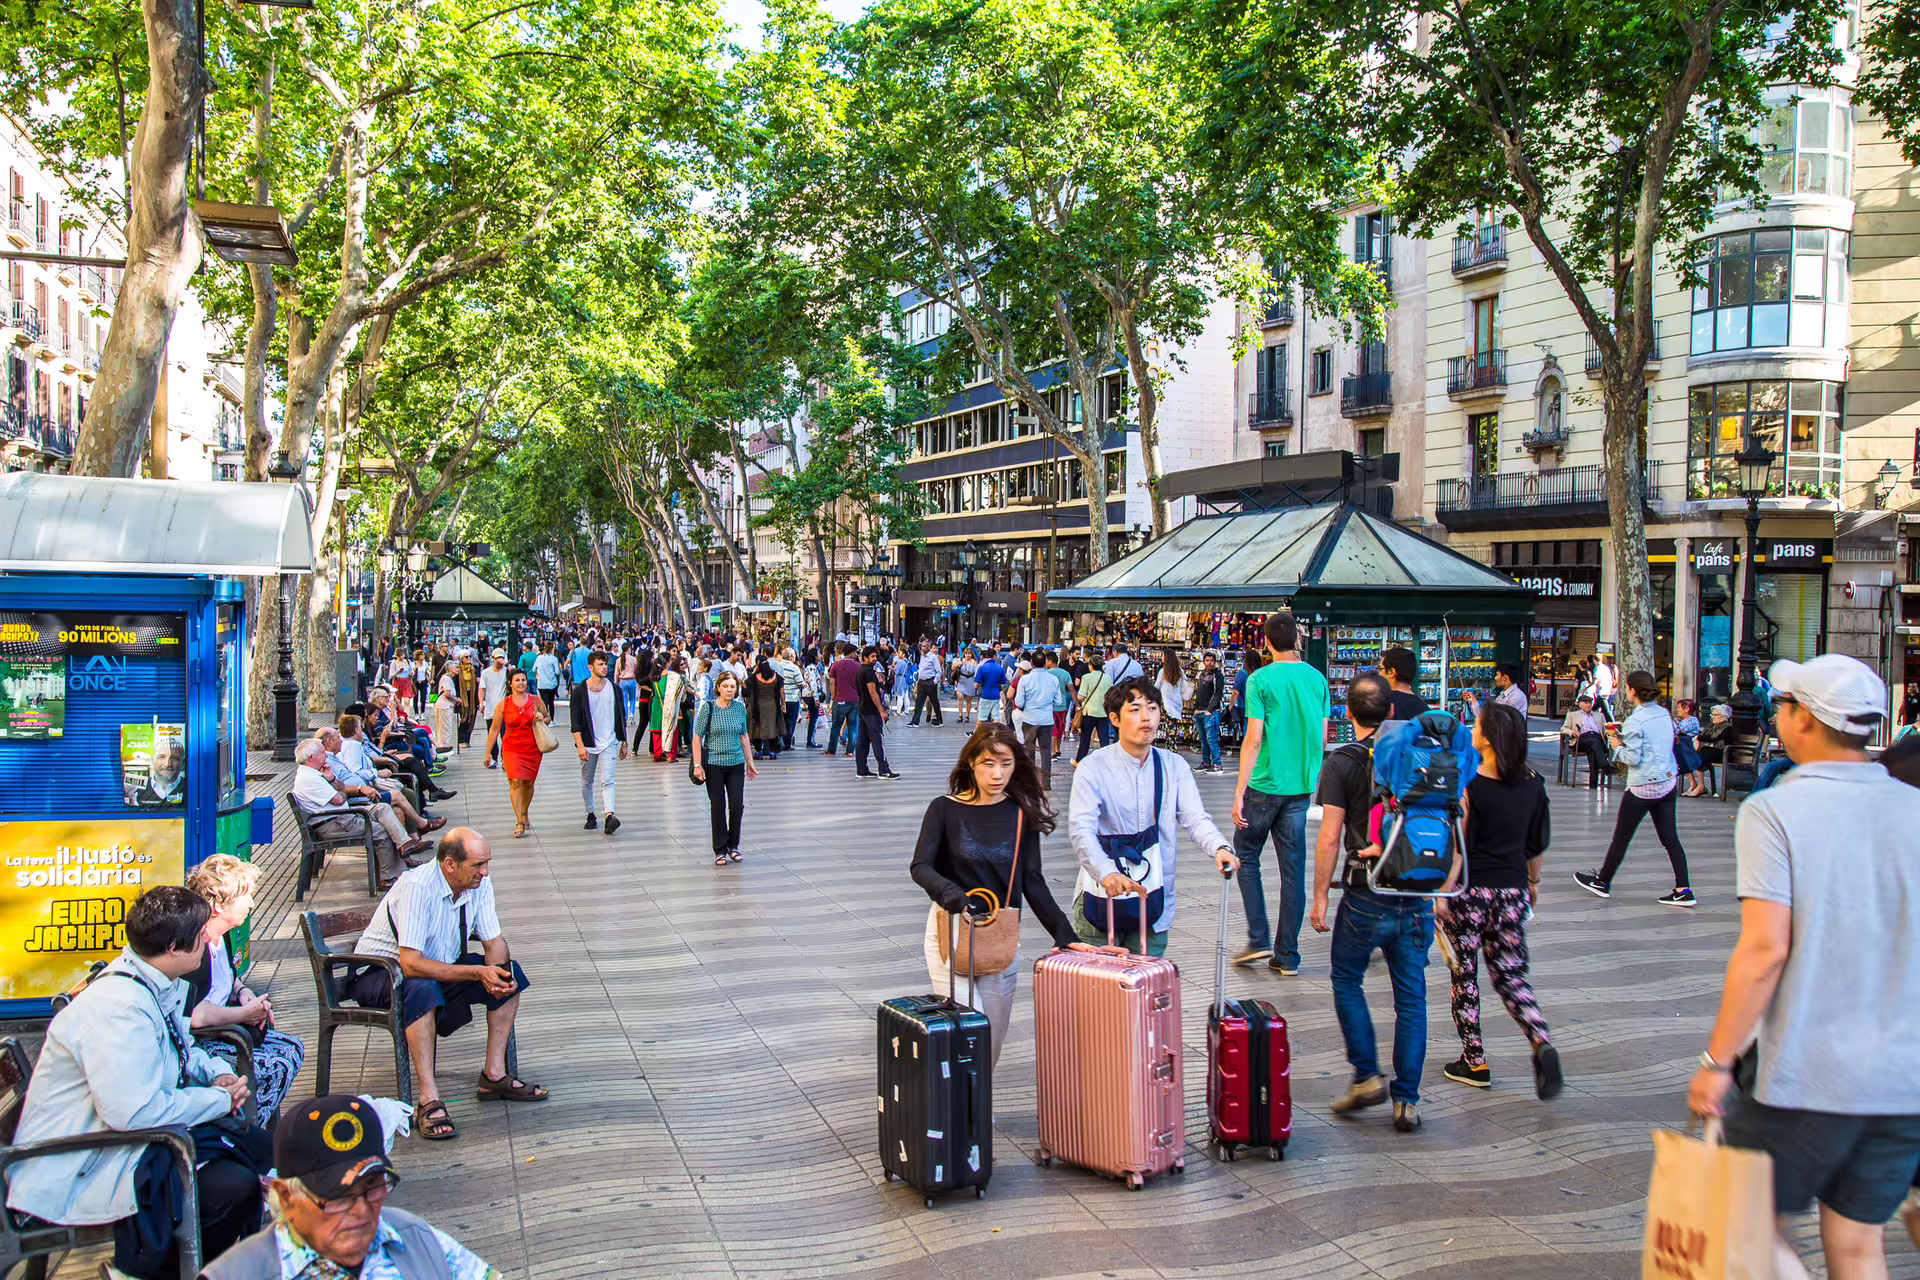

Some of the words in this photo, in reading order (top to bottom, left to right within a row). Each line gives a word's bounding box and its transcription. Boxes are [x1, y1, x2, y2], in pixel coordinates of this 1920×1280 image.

[1773, 544, 1815, 560] pans
[1696, 555, 1730, 569] pans
[1569, 583, 1594, 596] COMPANY
[0, 632, 38, 642] ACKPOT
[59, 631, 78, 643] 90
[80, 631, 137, 644] MILIONS
[69, 675, 127, 690] ONCE
[6, 857, 23, 866] La
[25, 855, 54, 866] teva
[138, 854, 153, 863] és
[16, 864, 142, 887] solidària
[51, 897, 126, 926] EURO
[24, 923, 127, 952] JACKPO
